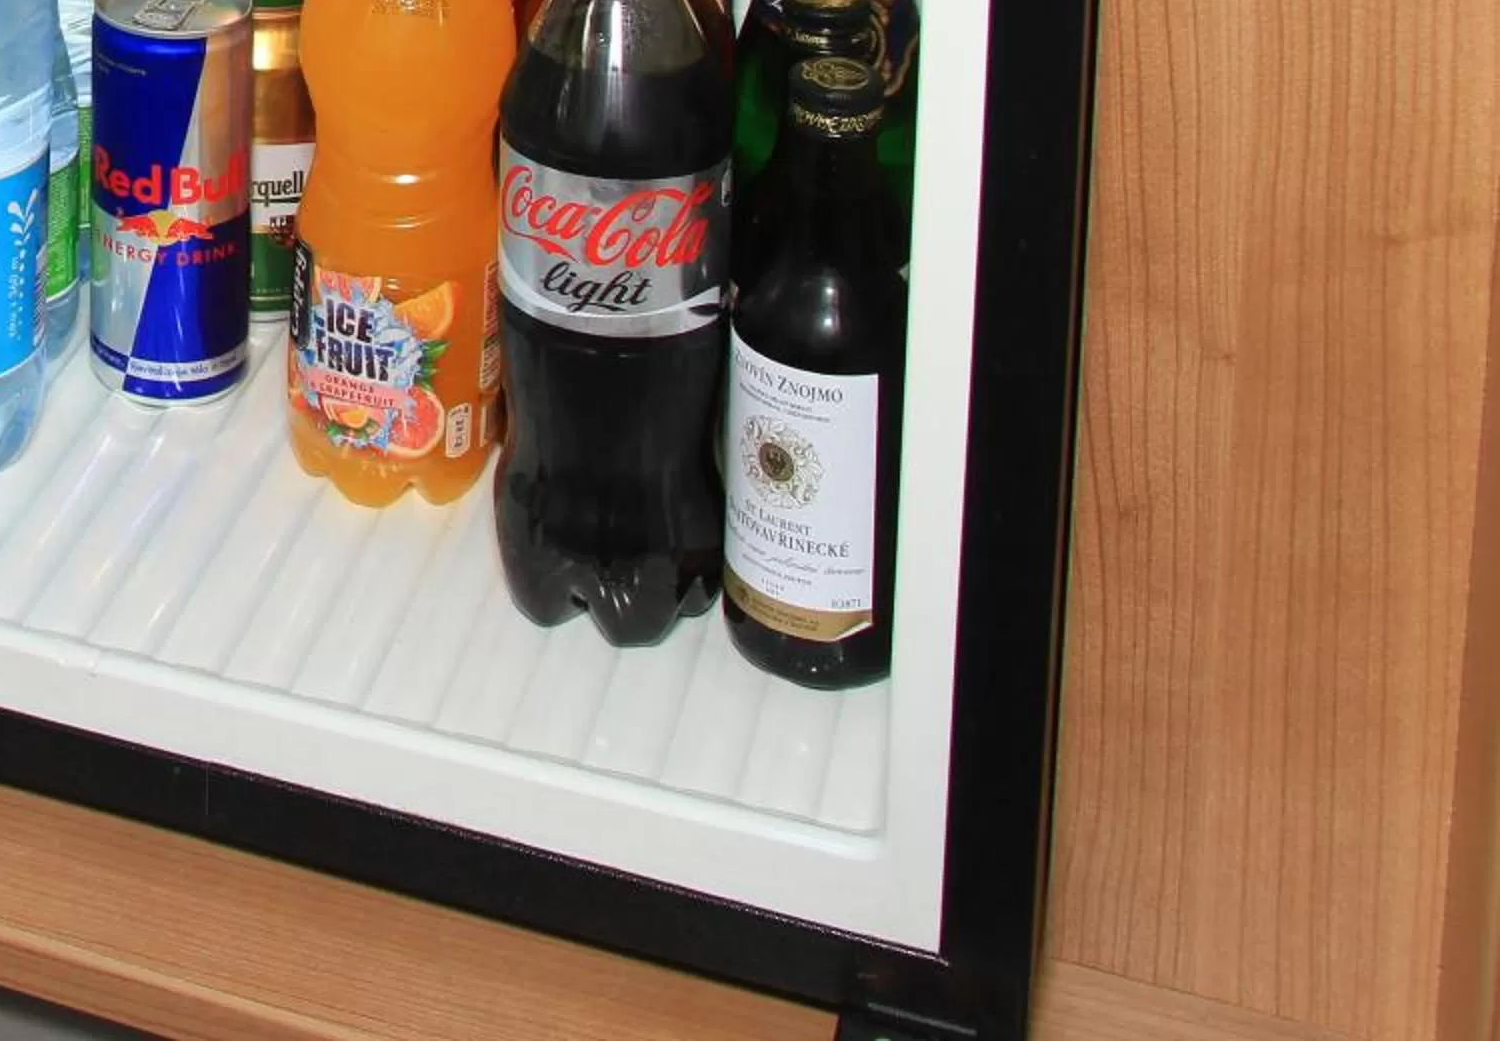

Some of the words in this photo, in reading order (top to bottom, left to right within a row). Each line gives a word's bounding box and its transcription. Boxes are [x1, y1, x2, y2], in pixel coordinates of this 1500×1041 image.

[92, 142, 162, 206] Red
[171, 145, 247, 206] Bull
[251, 170, 304, 207] rquell
[501, 165, 715, 268] Coca-Cola
[102, 233, 167, 266] NERGY
[540, 262, 653, 312] light
[325, 298, 376, 343] ICE
[315, 328, 394, 383] FRUIT
[324, 374, 375, 394] ORANGE
[777, 375, 843, 404] ZNOJMO
